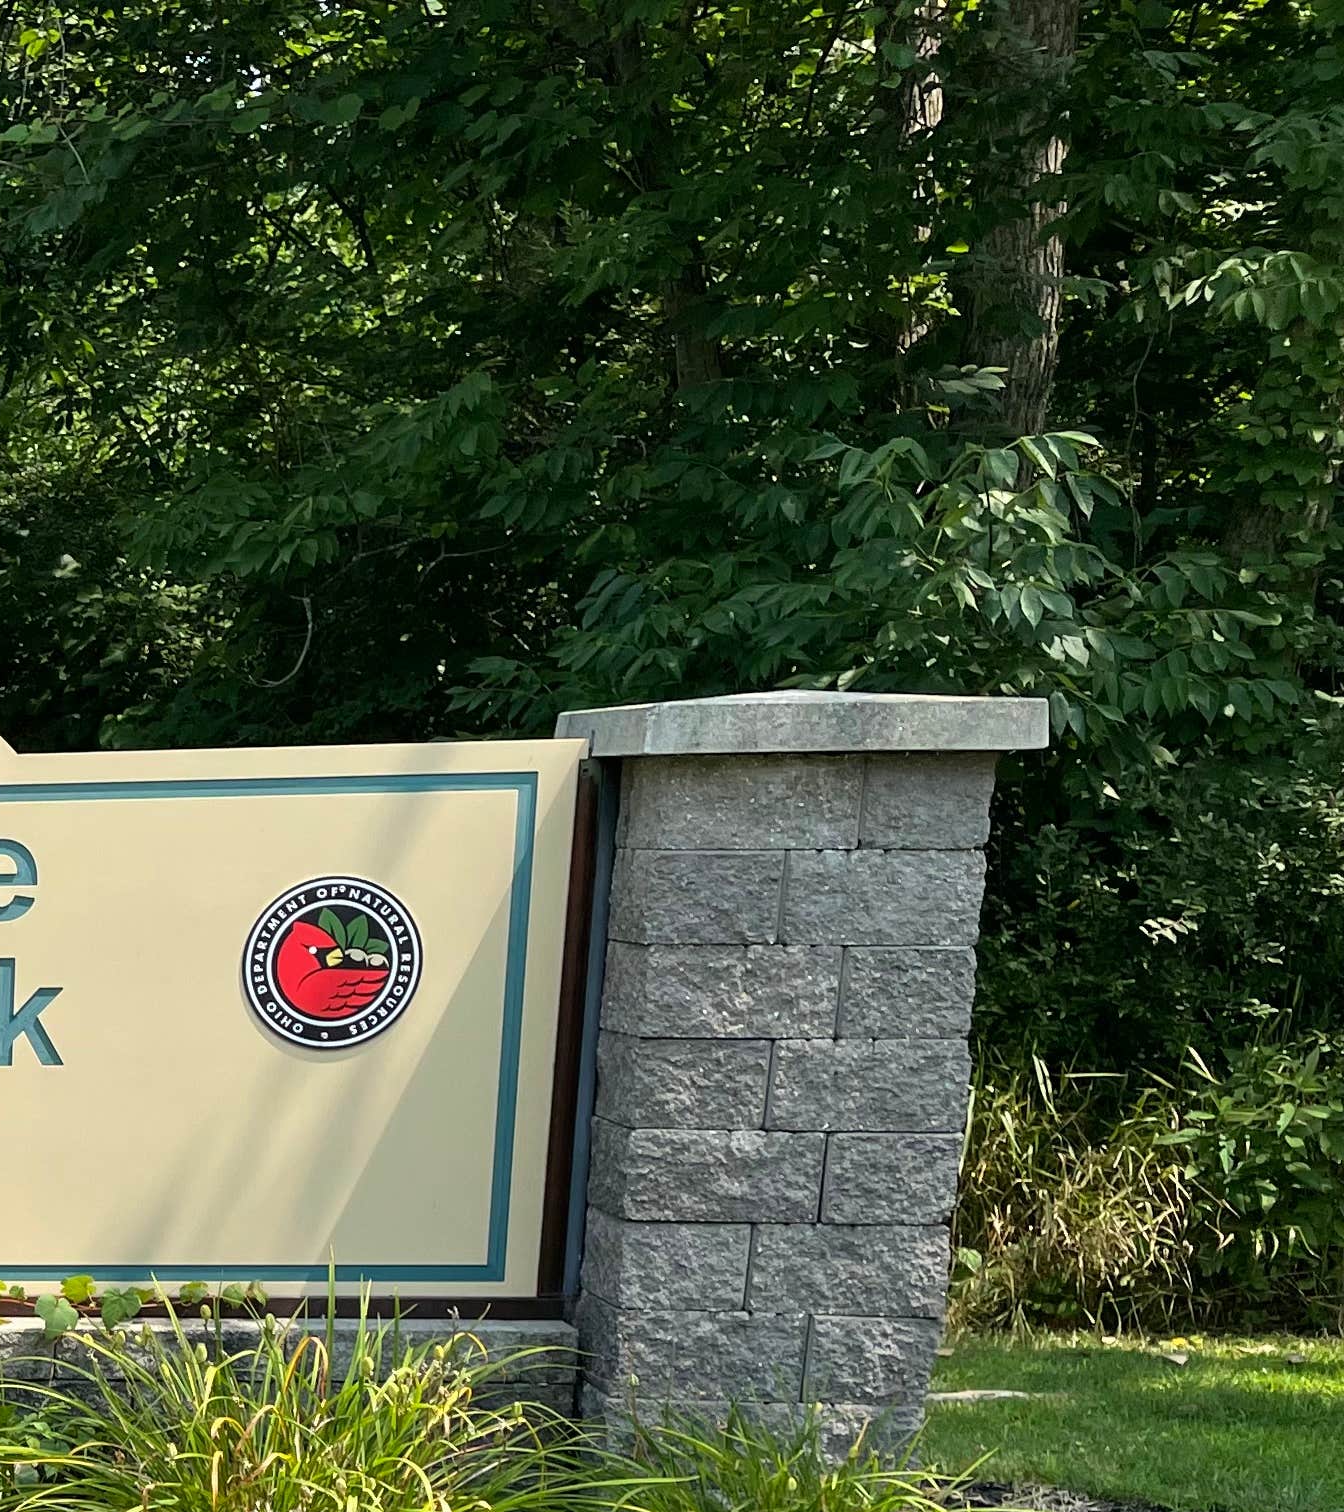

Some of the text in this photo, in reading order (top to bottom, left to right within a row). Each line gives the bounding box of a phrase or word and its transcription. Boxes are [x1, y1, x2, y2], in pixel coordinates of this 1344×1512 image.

[252, 886, 412, 1036] OHIO DEPARTMENT OF NATURAL RESOURCES
